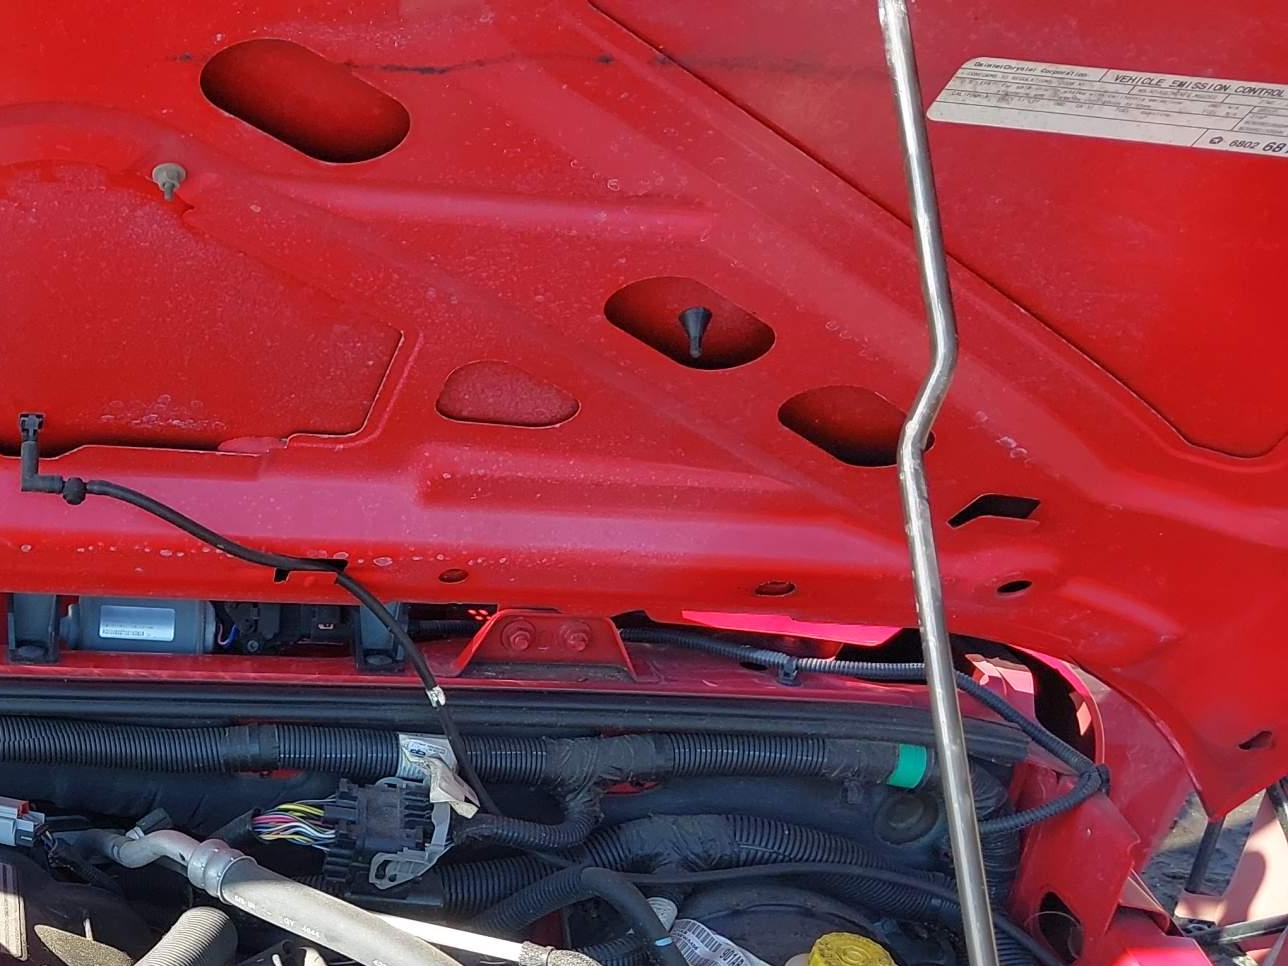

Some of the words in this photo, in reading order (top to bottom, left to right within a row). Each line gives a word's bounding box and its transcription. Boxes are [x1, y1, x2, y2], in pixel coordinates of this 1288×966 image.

[1040, 67, 1088, 78] Corporation
[1114, 74, 1162, 88] VEHICLE
[1169, 80, 1231, 93] EMISSION
[1234, 85, 1285, 98] CONTROL
[1229, 139, 1260, 150] 6802
[1263, 141, 1288, 154] 68
